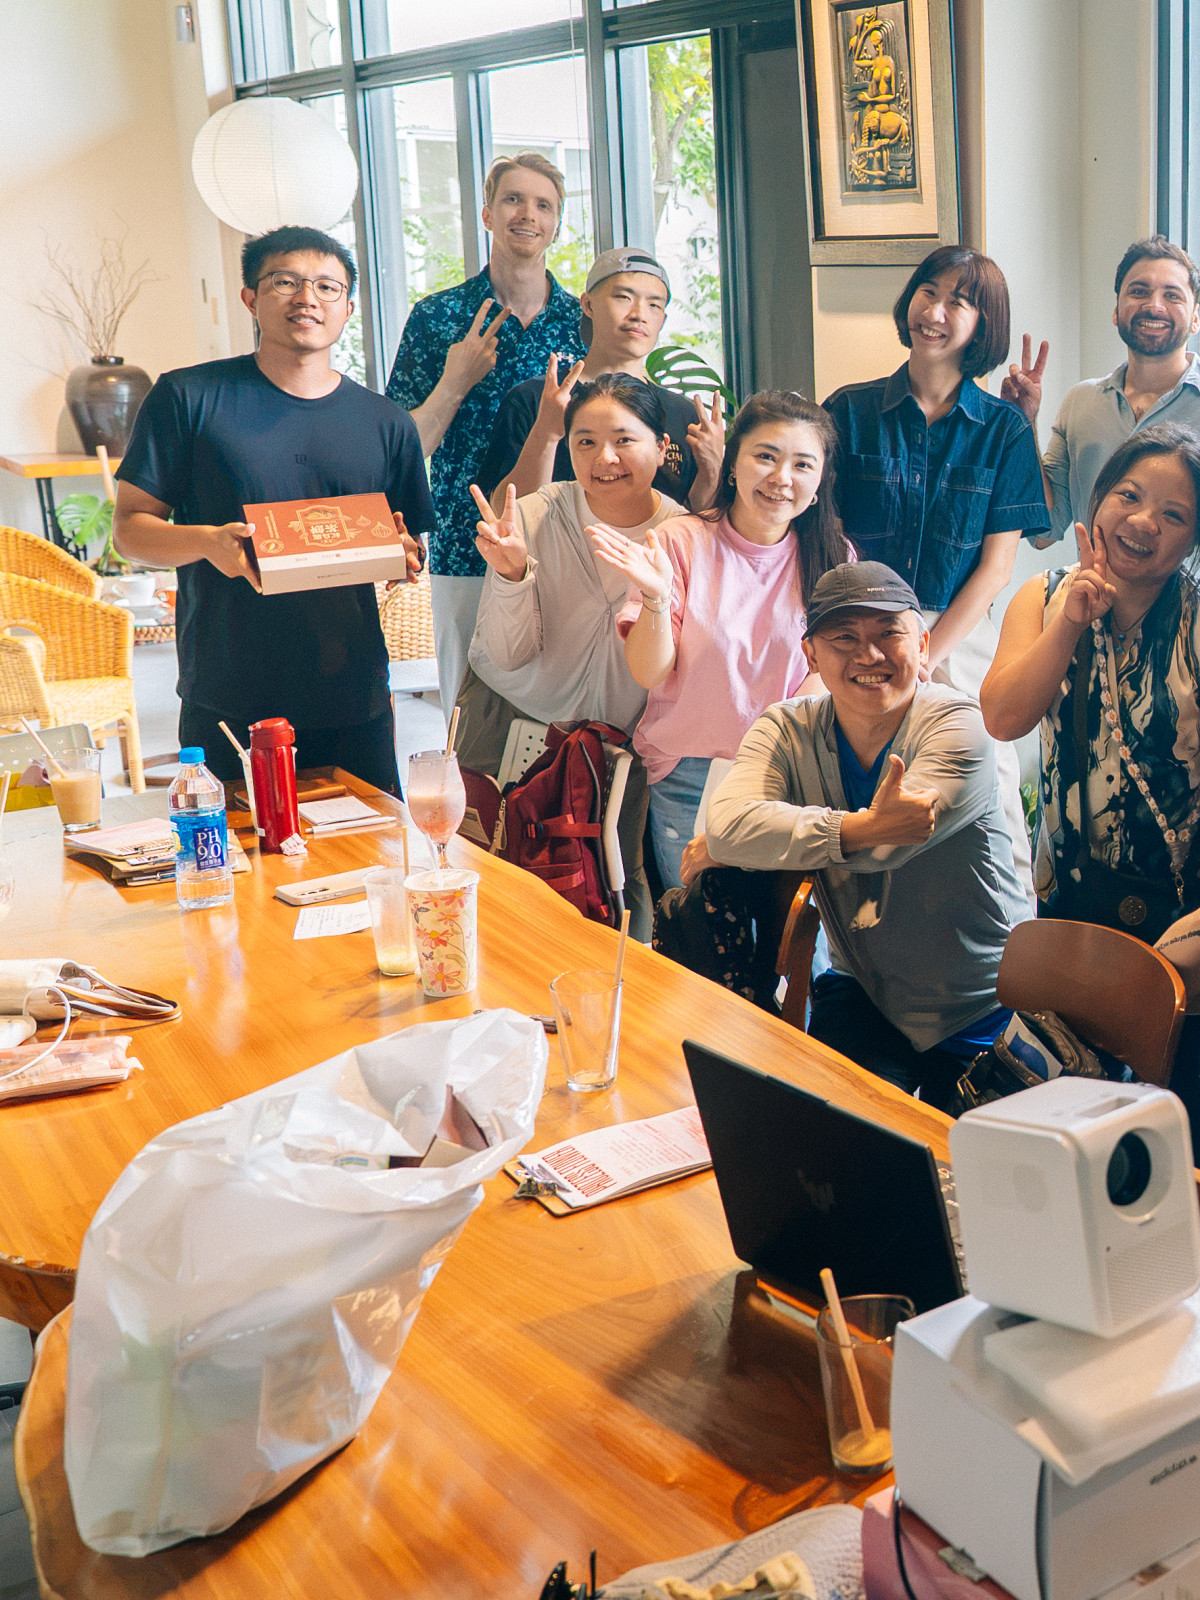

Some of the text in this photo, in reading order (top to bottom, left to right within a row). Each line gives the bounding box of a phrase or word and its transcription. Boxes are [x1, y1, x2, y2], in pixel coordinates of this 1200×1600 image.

[196, 827, 220, 845] PH
[197, 843, 221, 860] 9.0
[541, 1144, 591, 1176] FLOWER
